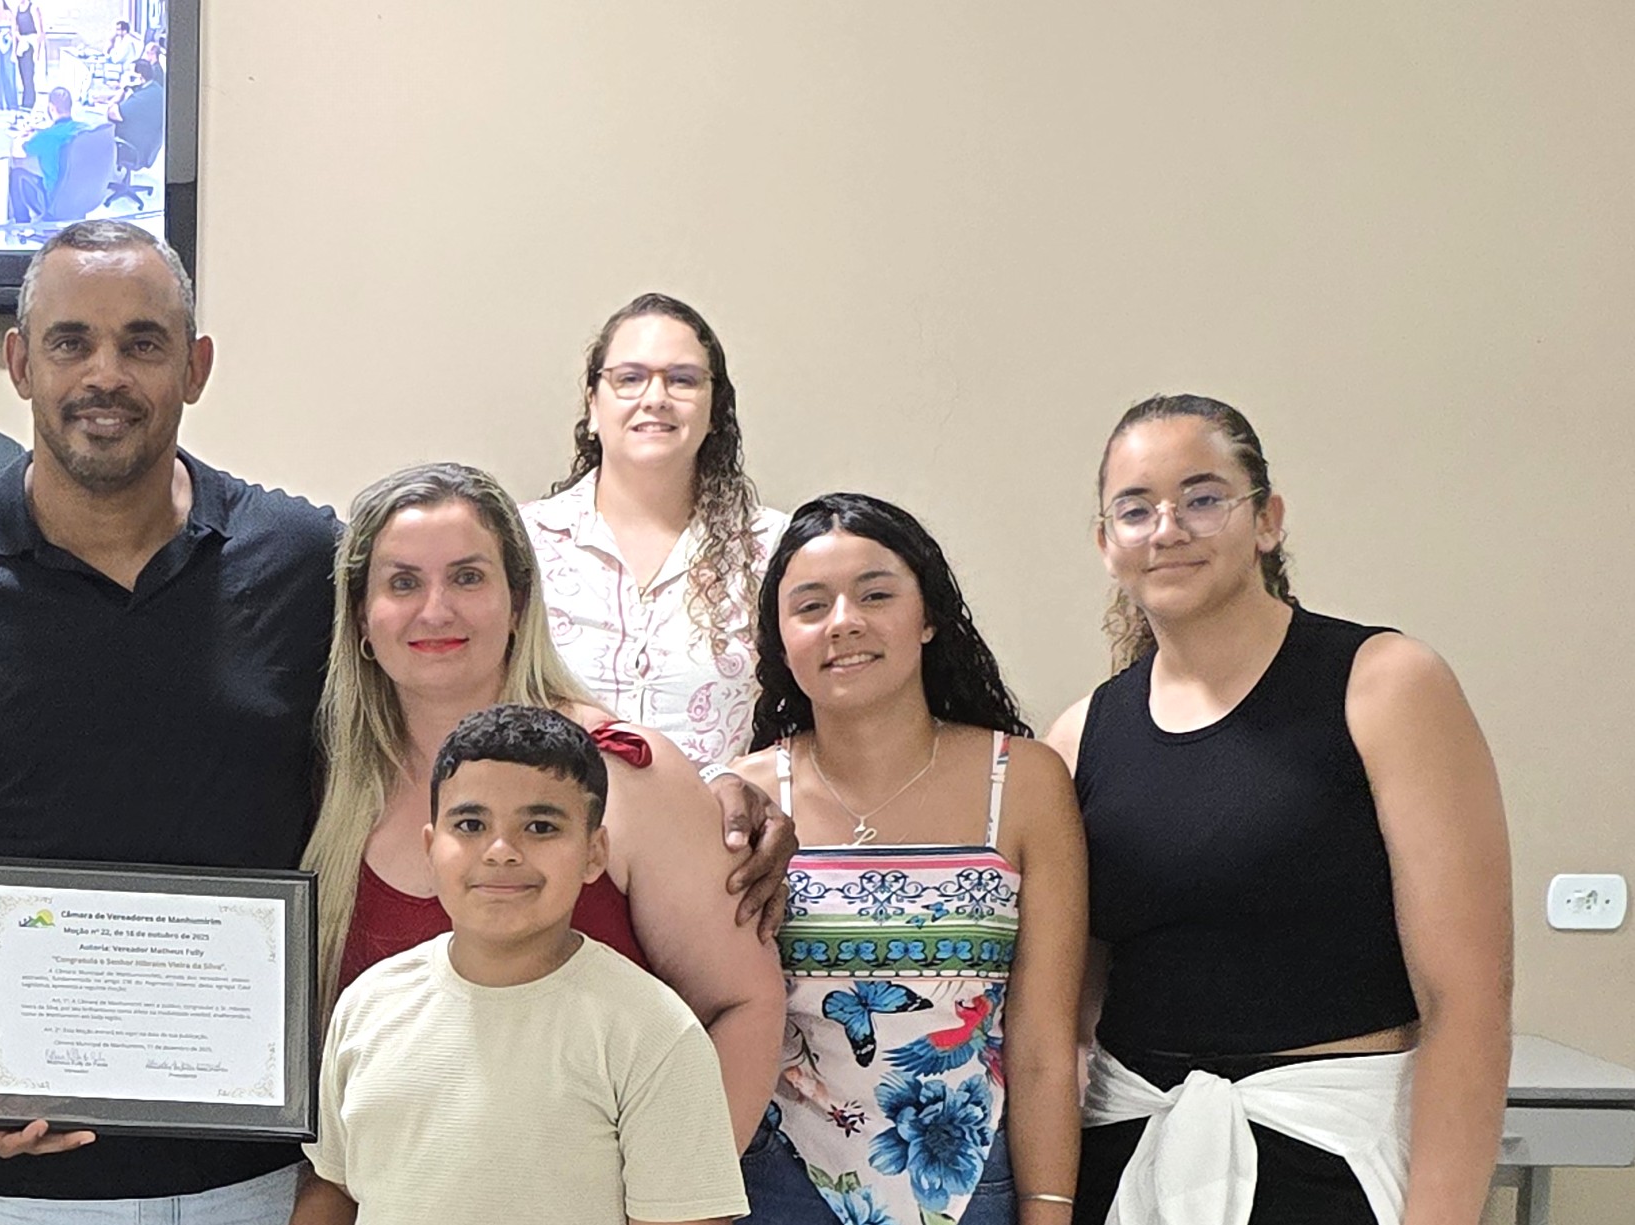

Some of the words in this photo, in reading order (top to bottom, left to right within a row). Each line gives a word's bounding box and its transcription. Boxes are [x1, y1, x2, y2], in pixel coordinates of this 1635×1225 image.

[60, 910, 93, 919] Câmara
[105, 913, 153, 922] Vereadores
[113, 928, 124, 936] de
